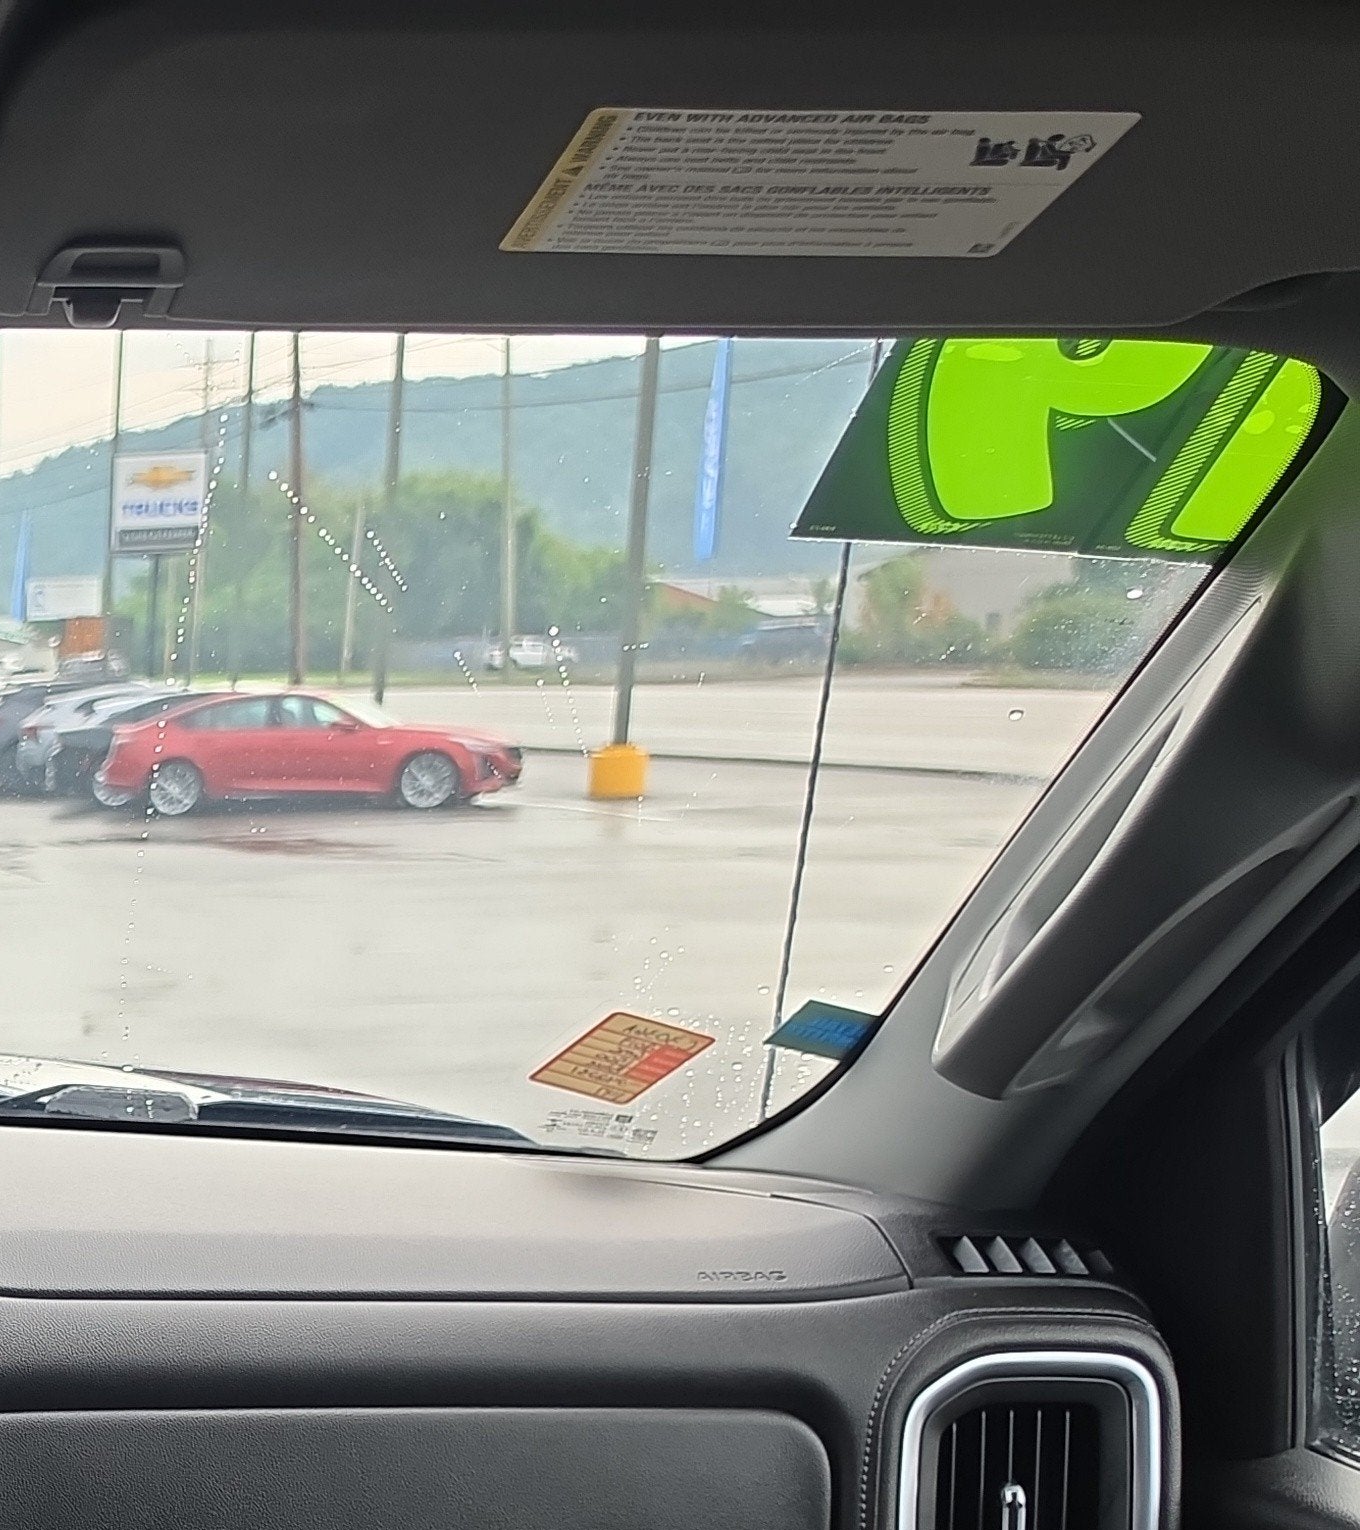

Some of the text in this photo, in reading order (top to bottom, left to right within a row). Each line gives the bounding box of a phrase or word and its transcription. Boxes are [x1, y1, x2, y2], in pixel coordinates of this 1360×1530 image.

[633, 112, 931, 125] EVEN WITH ADVANCED AIR BAGS
[697, 1270, 787, 1282] AIRBAG
